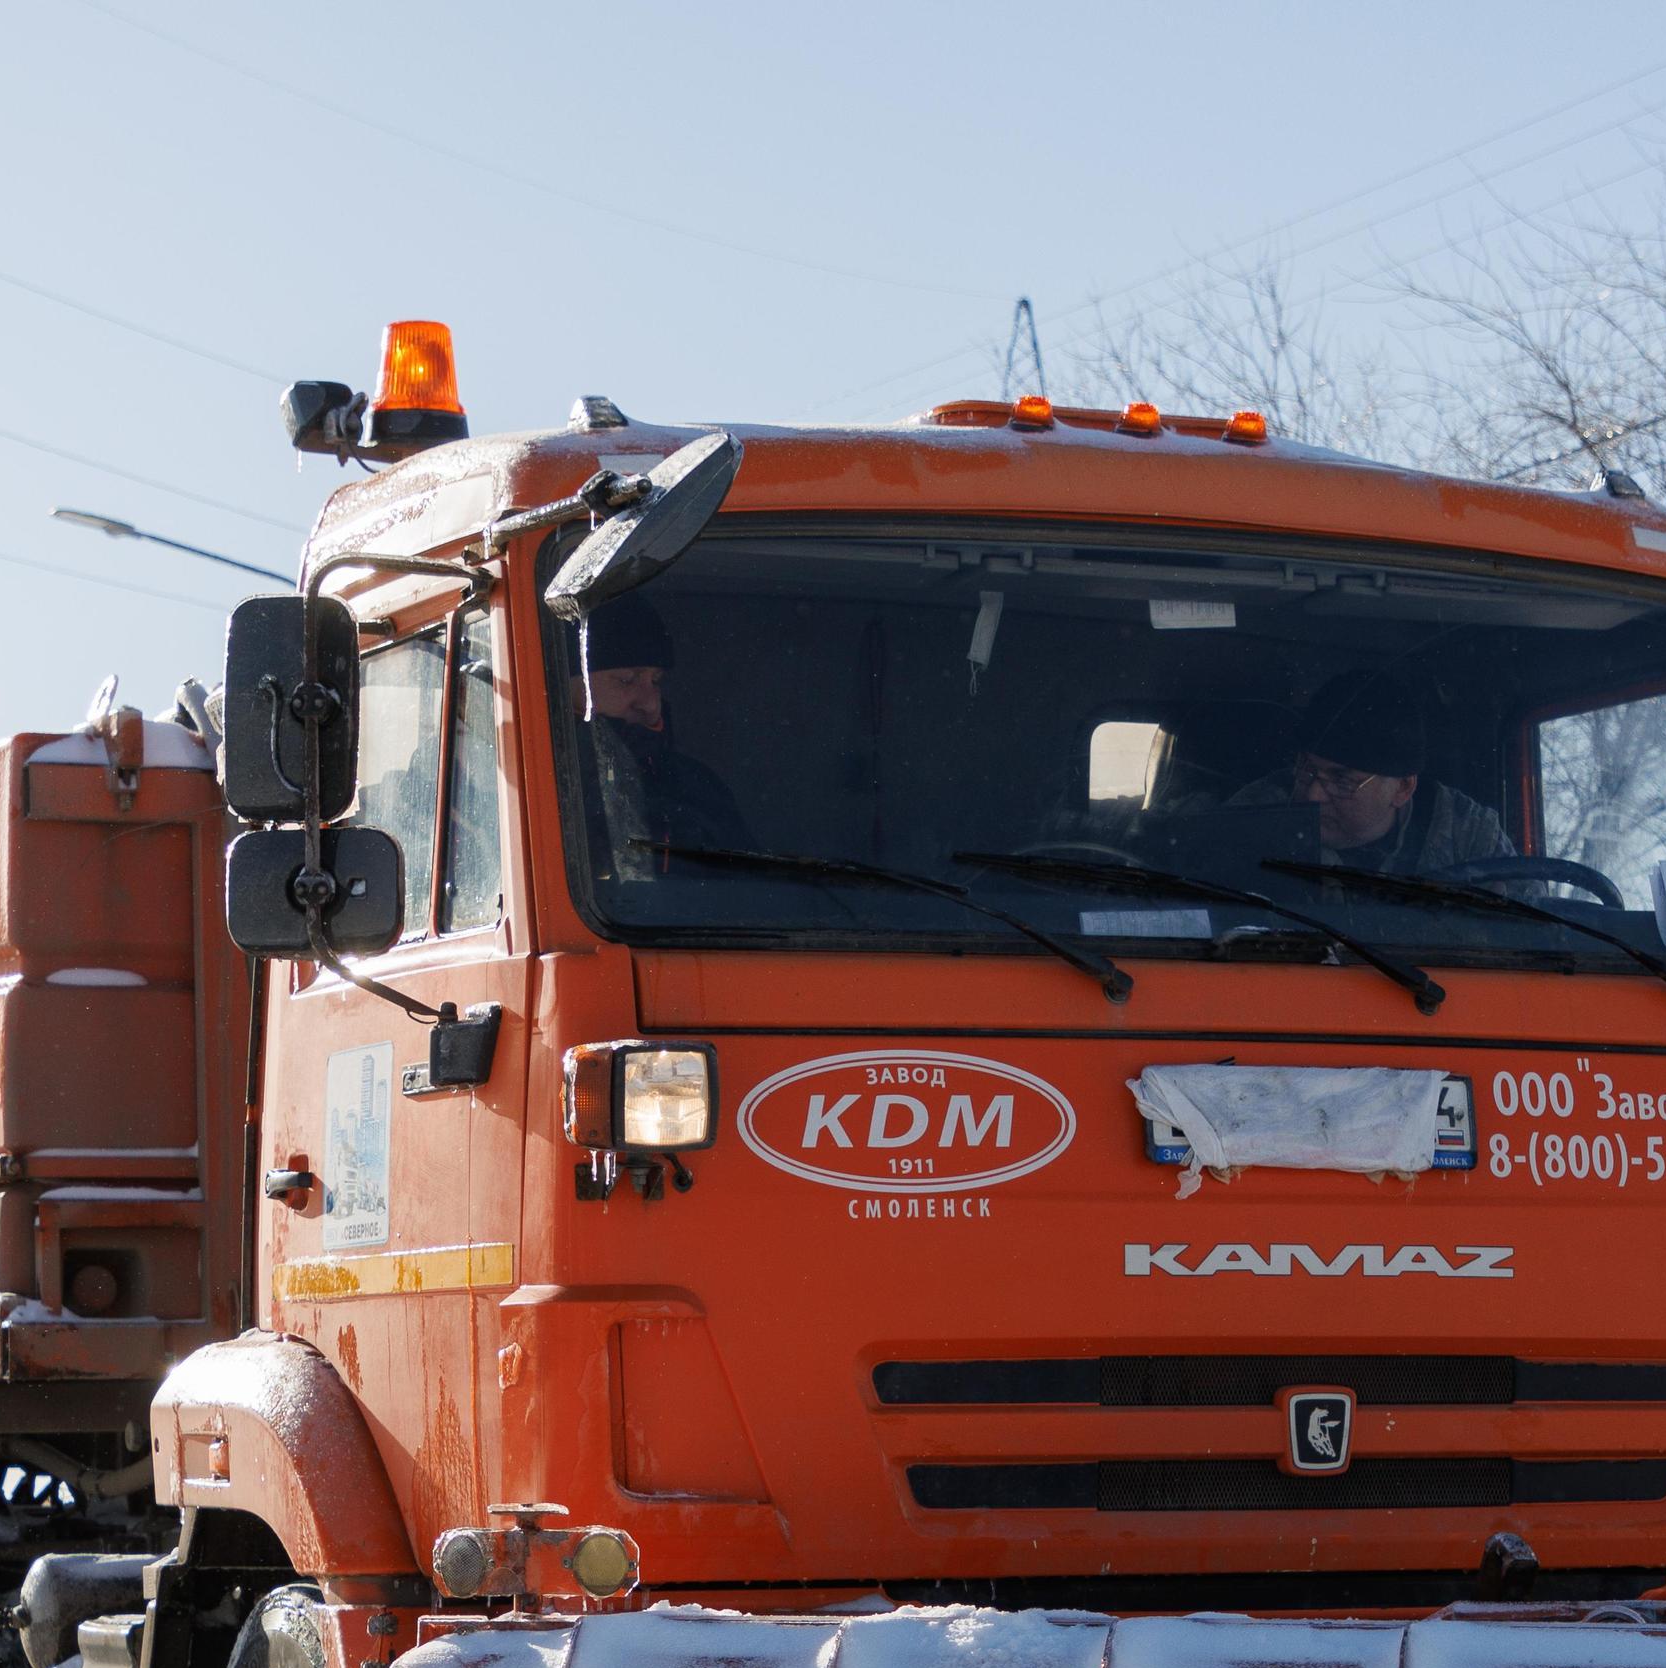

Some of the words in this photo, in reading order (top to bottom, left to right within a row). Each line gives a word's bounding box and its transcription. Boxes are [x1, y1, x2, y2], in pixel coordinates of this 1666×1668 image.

[865, 1067, 947, 1089] ЗАВОД
[1492, 1070, 1575, 1118] ООО
[801, 1094, 1015, 1148] KDM
[888, 1158, 935, 1175] 1911
[847, 1198, 991, 1220] СМОЛЕНСК
[1123, 1242, 1515, 1279] KAMAZ
